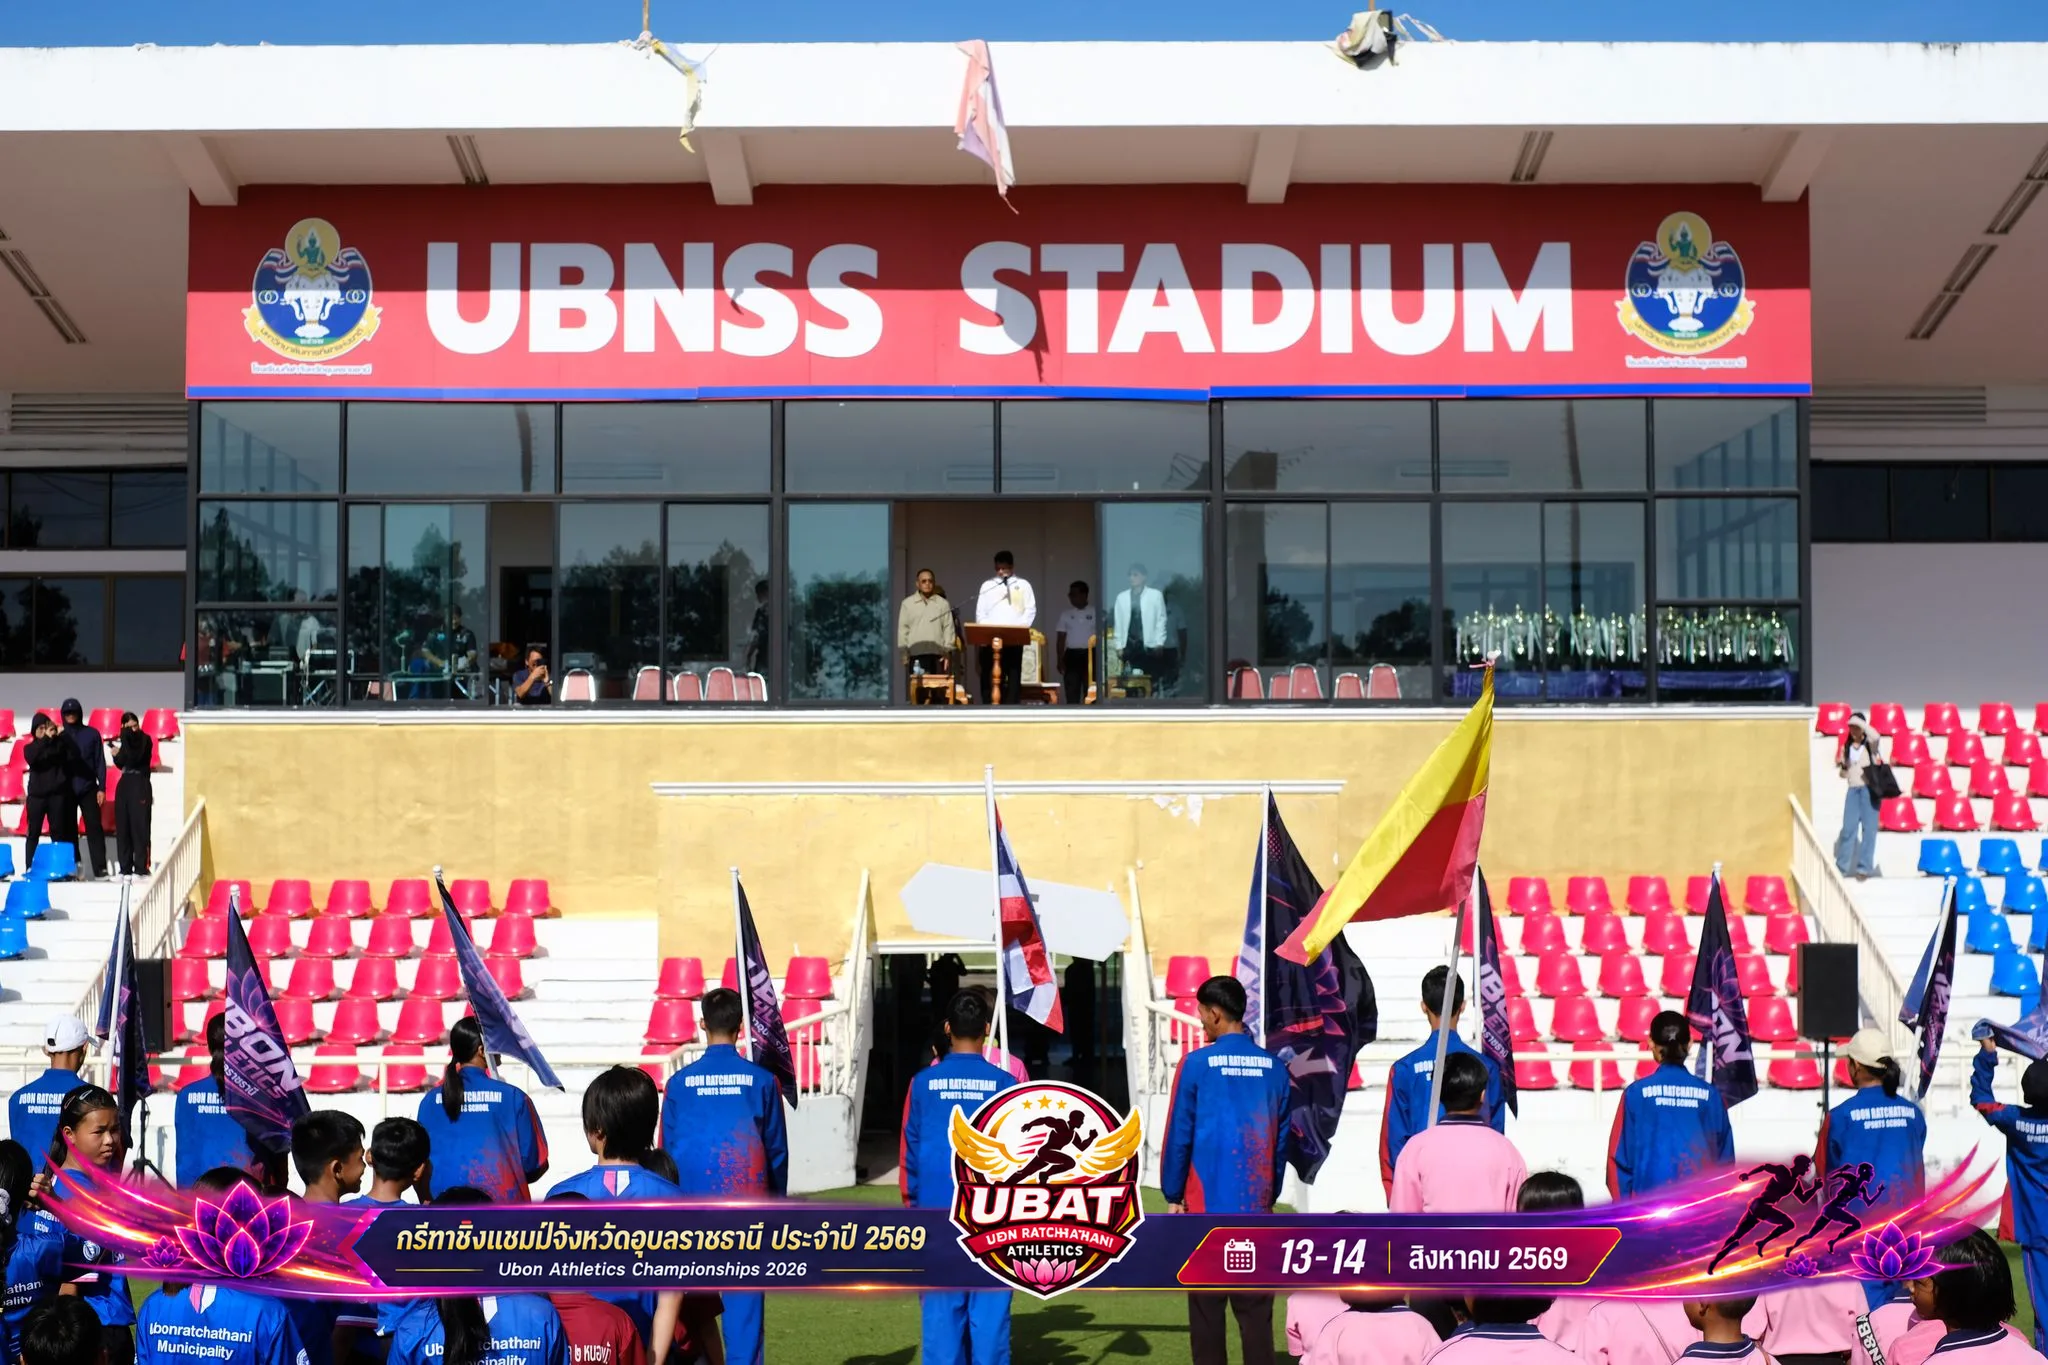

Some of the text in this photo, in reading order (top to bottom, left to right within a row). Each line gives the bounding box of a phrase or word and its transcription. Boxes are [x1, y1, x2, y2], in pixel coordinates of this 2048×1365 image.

[425, 240, 1574, 358] UBNSS STADIUM
[464, 1091, 502, 1103] TCHATHANI
[157, 1339, 234, 1361] Municipality
